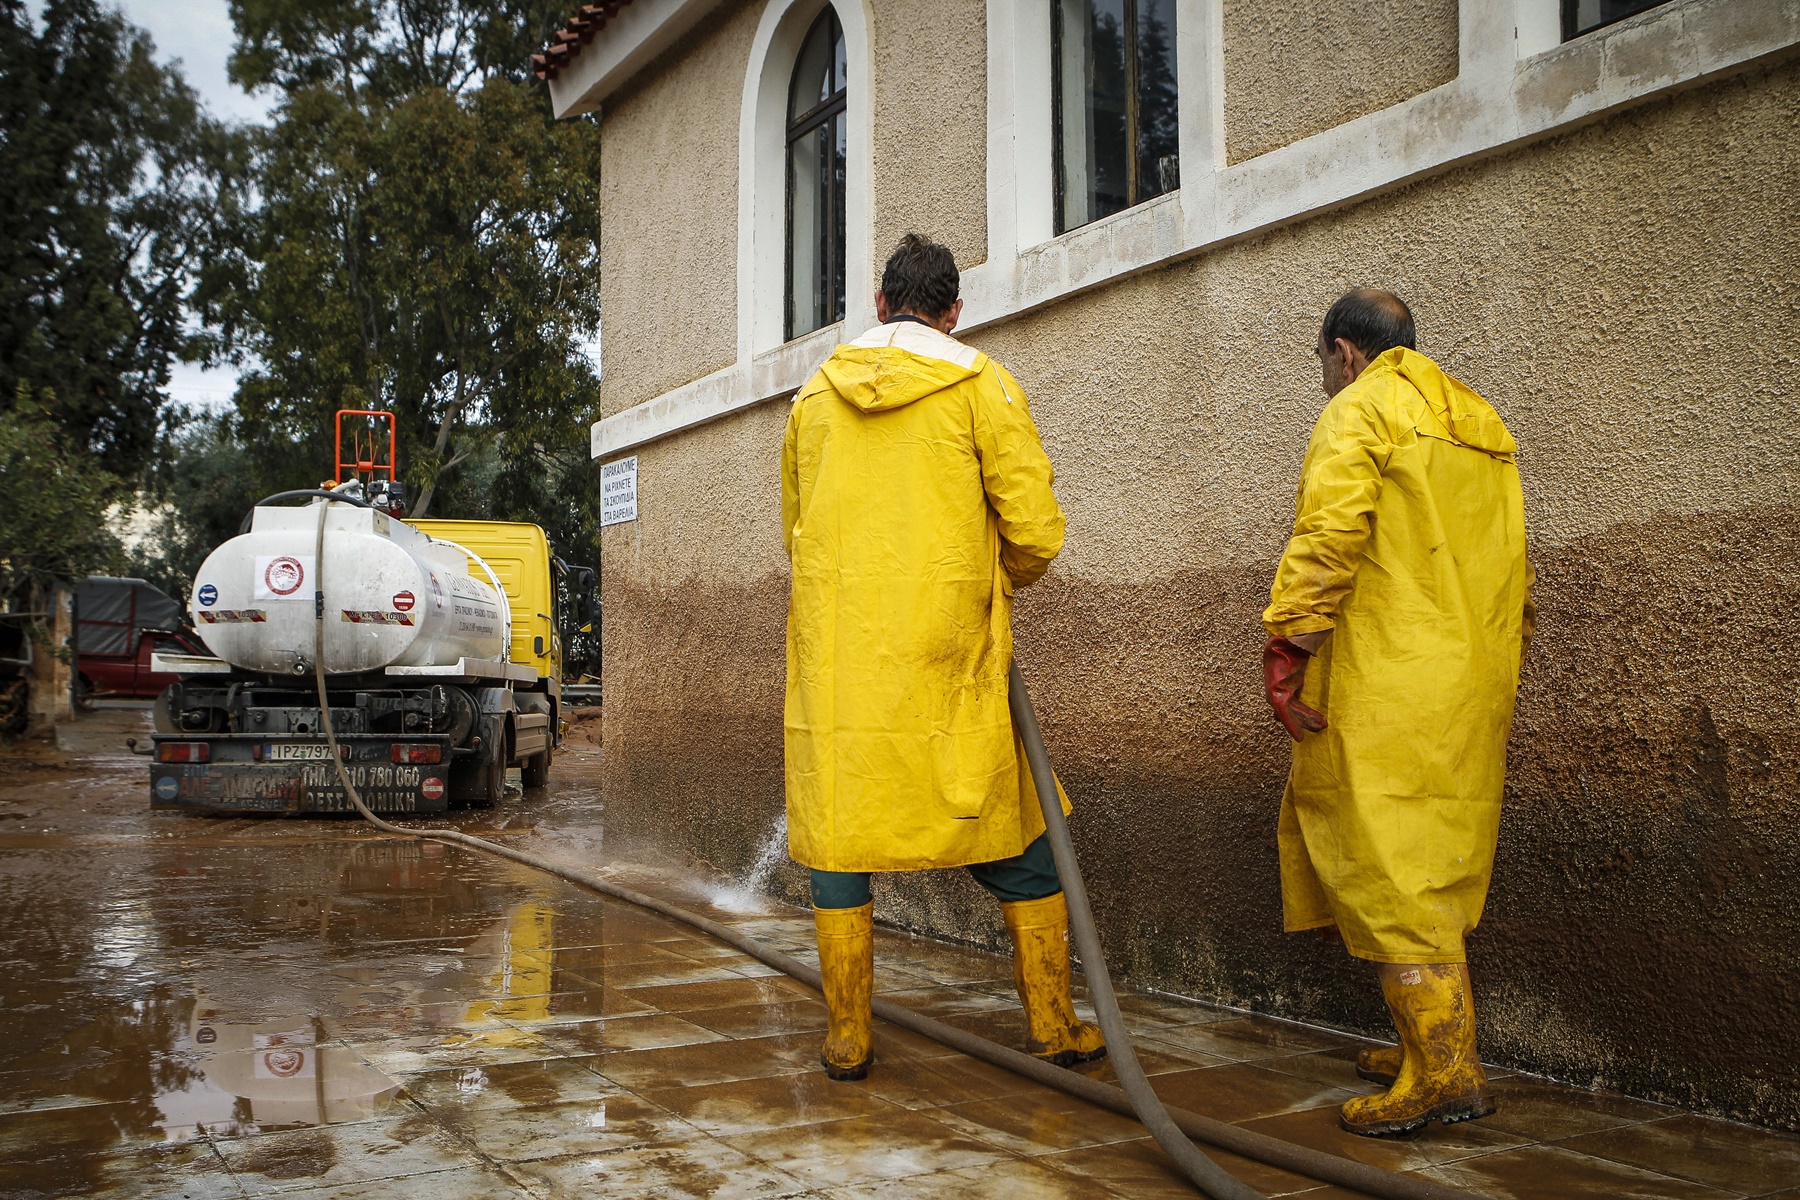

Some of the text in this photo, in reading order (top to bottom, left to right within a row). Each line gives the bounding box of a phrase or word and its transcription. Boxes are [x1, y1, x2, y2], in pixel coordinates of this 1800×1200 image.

[603, 459, 635, 478] ΠΑΡΑΚΑΛΟΥΜΕ
[604, 478, 631, 493] ΝΑ ΡΙΧΝΕΤΕ
[604, 491, 634, 507] ΤΑ ΣΚΟΥΠΙΔΙΑ
[604, 506, 633, 522] ΣΤΑ ΒΑΡΕΛΙΑ
[369, 766, 393, 787] 780
[396, 766, 419, 787] 060
